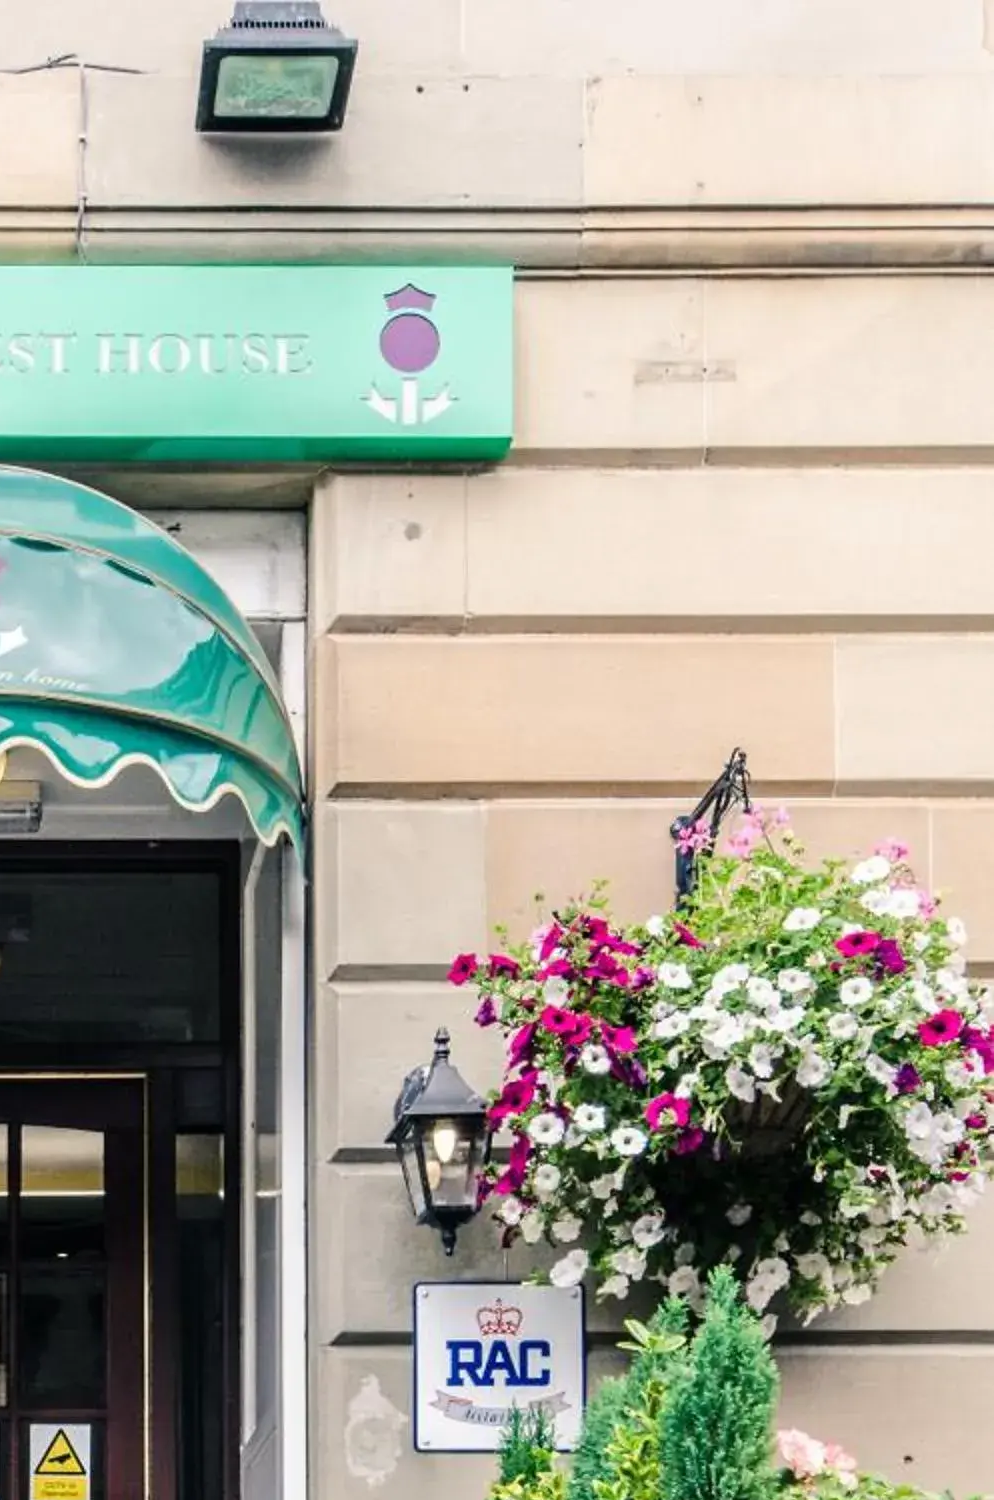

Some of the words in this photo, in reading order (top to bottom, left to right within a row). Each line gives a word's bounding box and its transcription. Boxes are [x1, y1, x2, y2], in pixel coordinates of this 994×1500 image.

[94, 332, 314, 375] HOUSE
[22, 668, 89, 691] home
[446, 1340, 551, 1387] RAC
